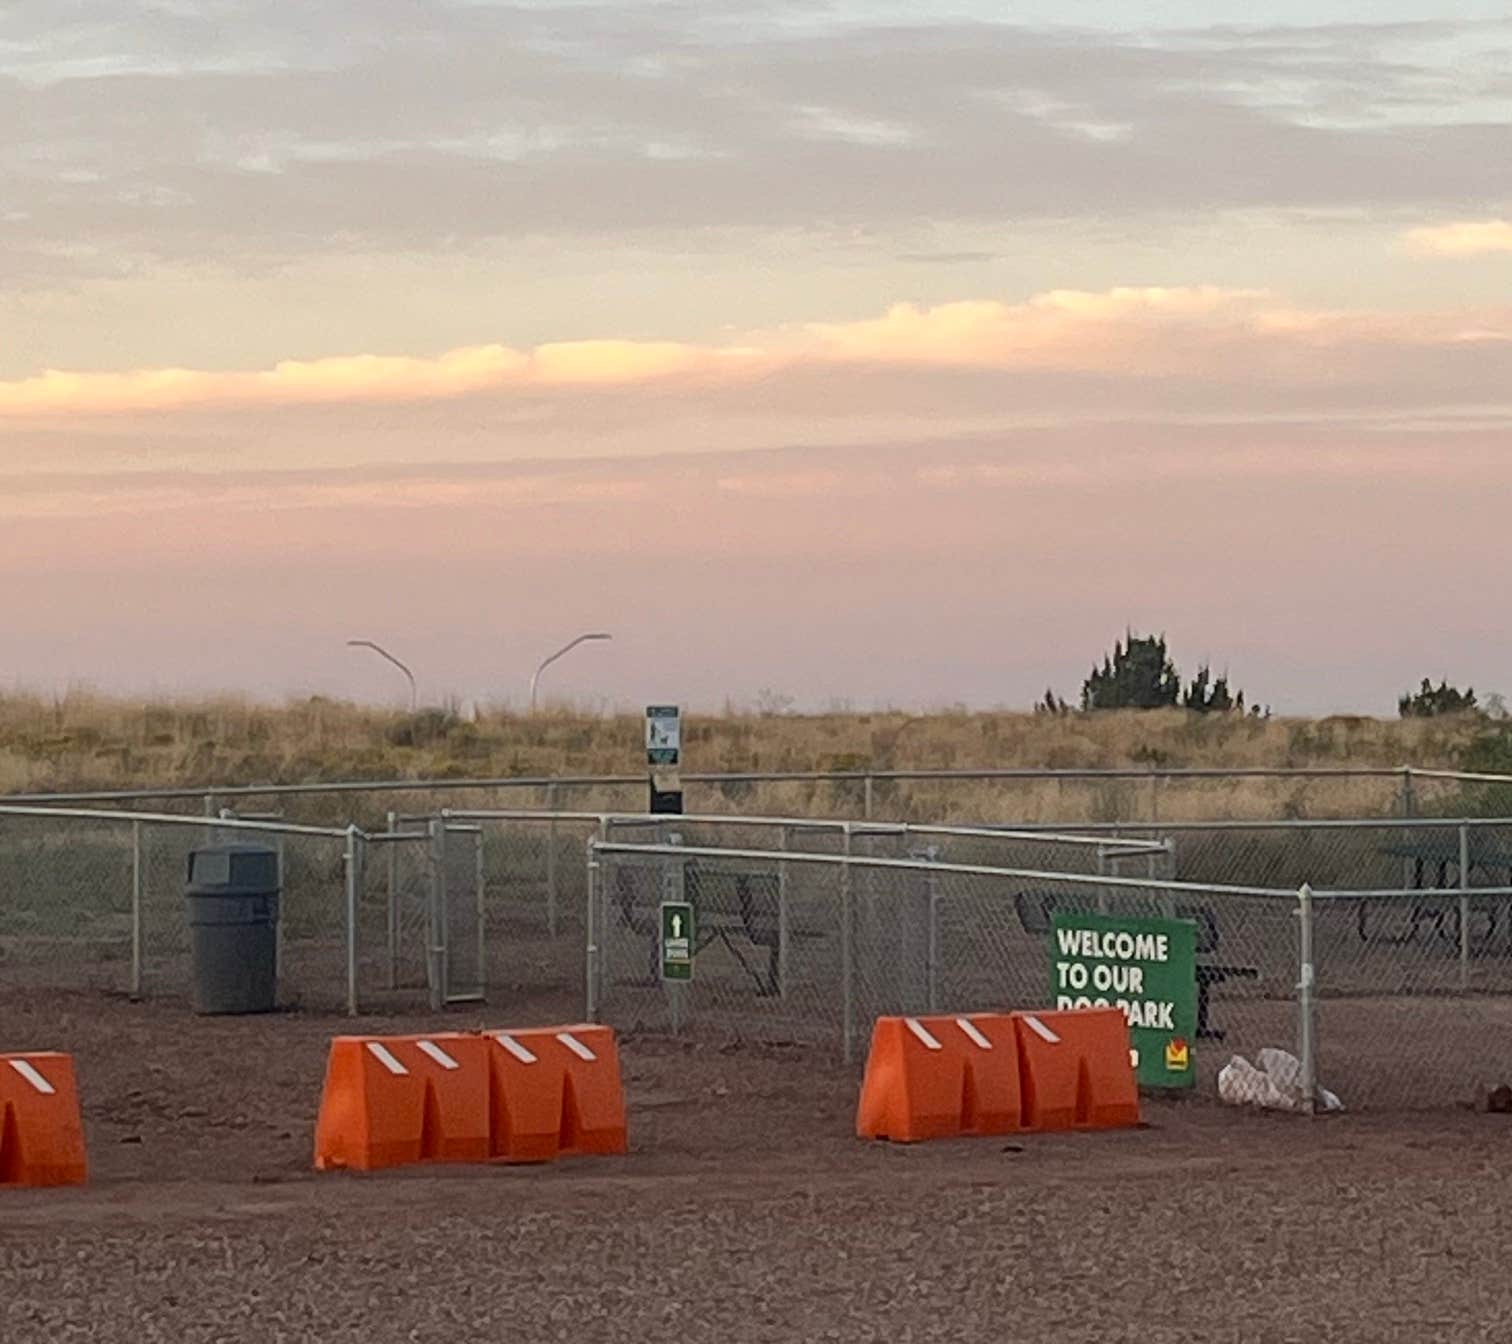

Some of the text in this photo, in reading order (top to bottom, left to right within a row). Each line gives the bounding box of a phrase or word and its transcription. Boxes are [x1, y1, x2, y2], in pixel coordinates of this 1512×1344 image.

[1057, 929, 1168, 961] WELCOME
[1057, 962, 1144, 994] TO OUR
[1116, 999, 1174, 1030] PARK
